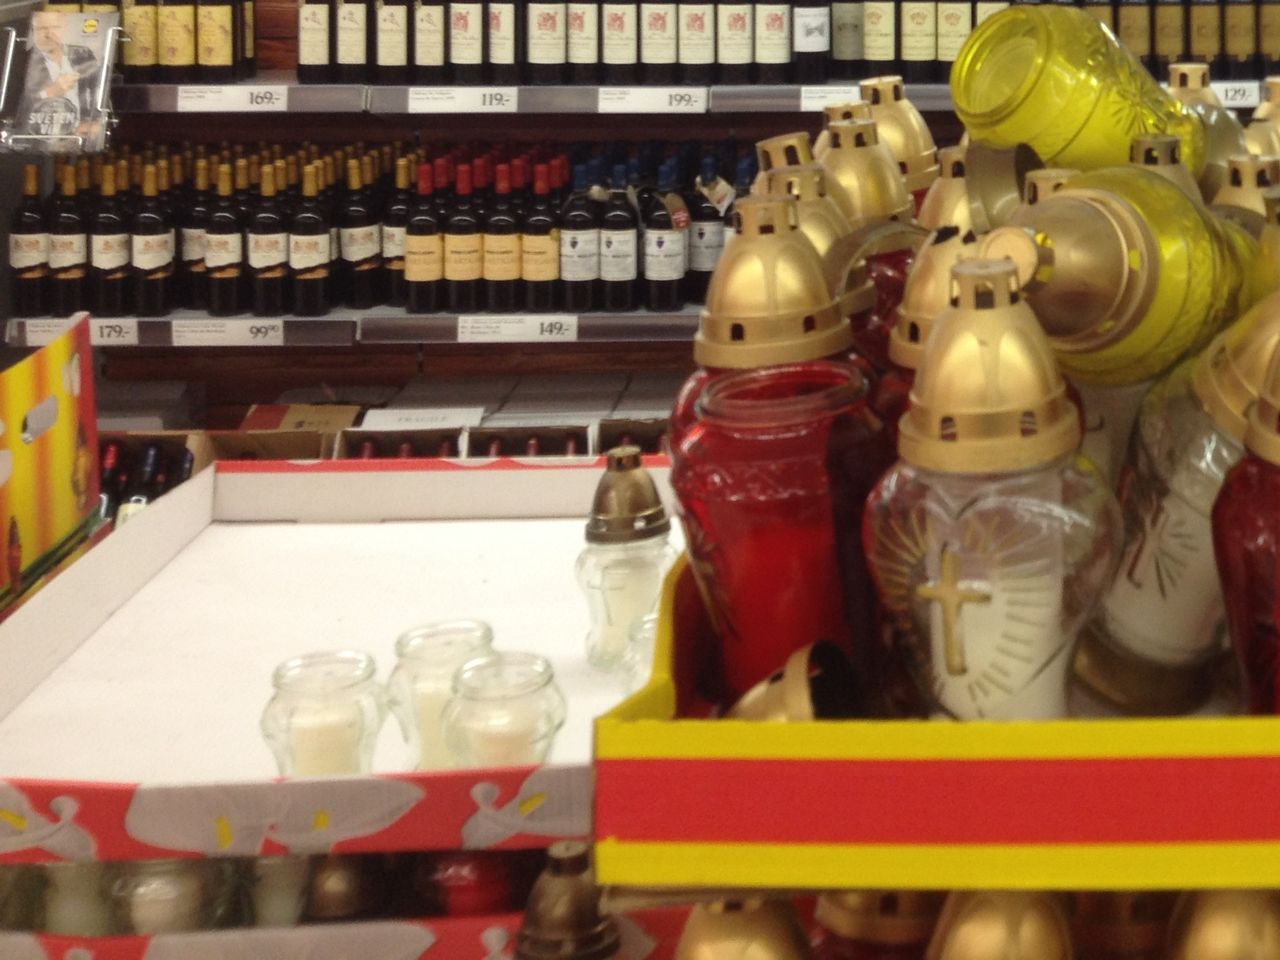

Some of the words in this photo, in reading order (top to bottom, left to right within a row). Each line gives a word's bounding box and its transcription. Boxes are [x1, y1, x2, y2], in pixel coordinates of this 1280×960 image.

[248, 90, 281, 105] 169.-
[481, 92, 510, 106] 119.-
[668, 93, 699, 107] 199.-
[99, 324, 130, 338] 179.-
[539, 320, 570, 336] 149.-
